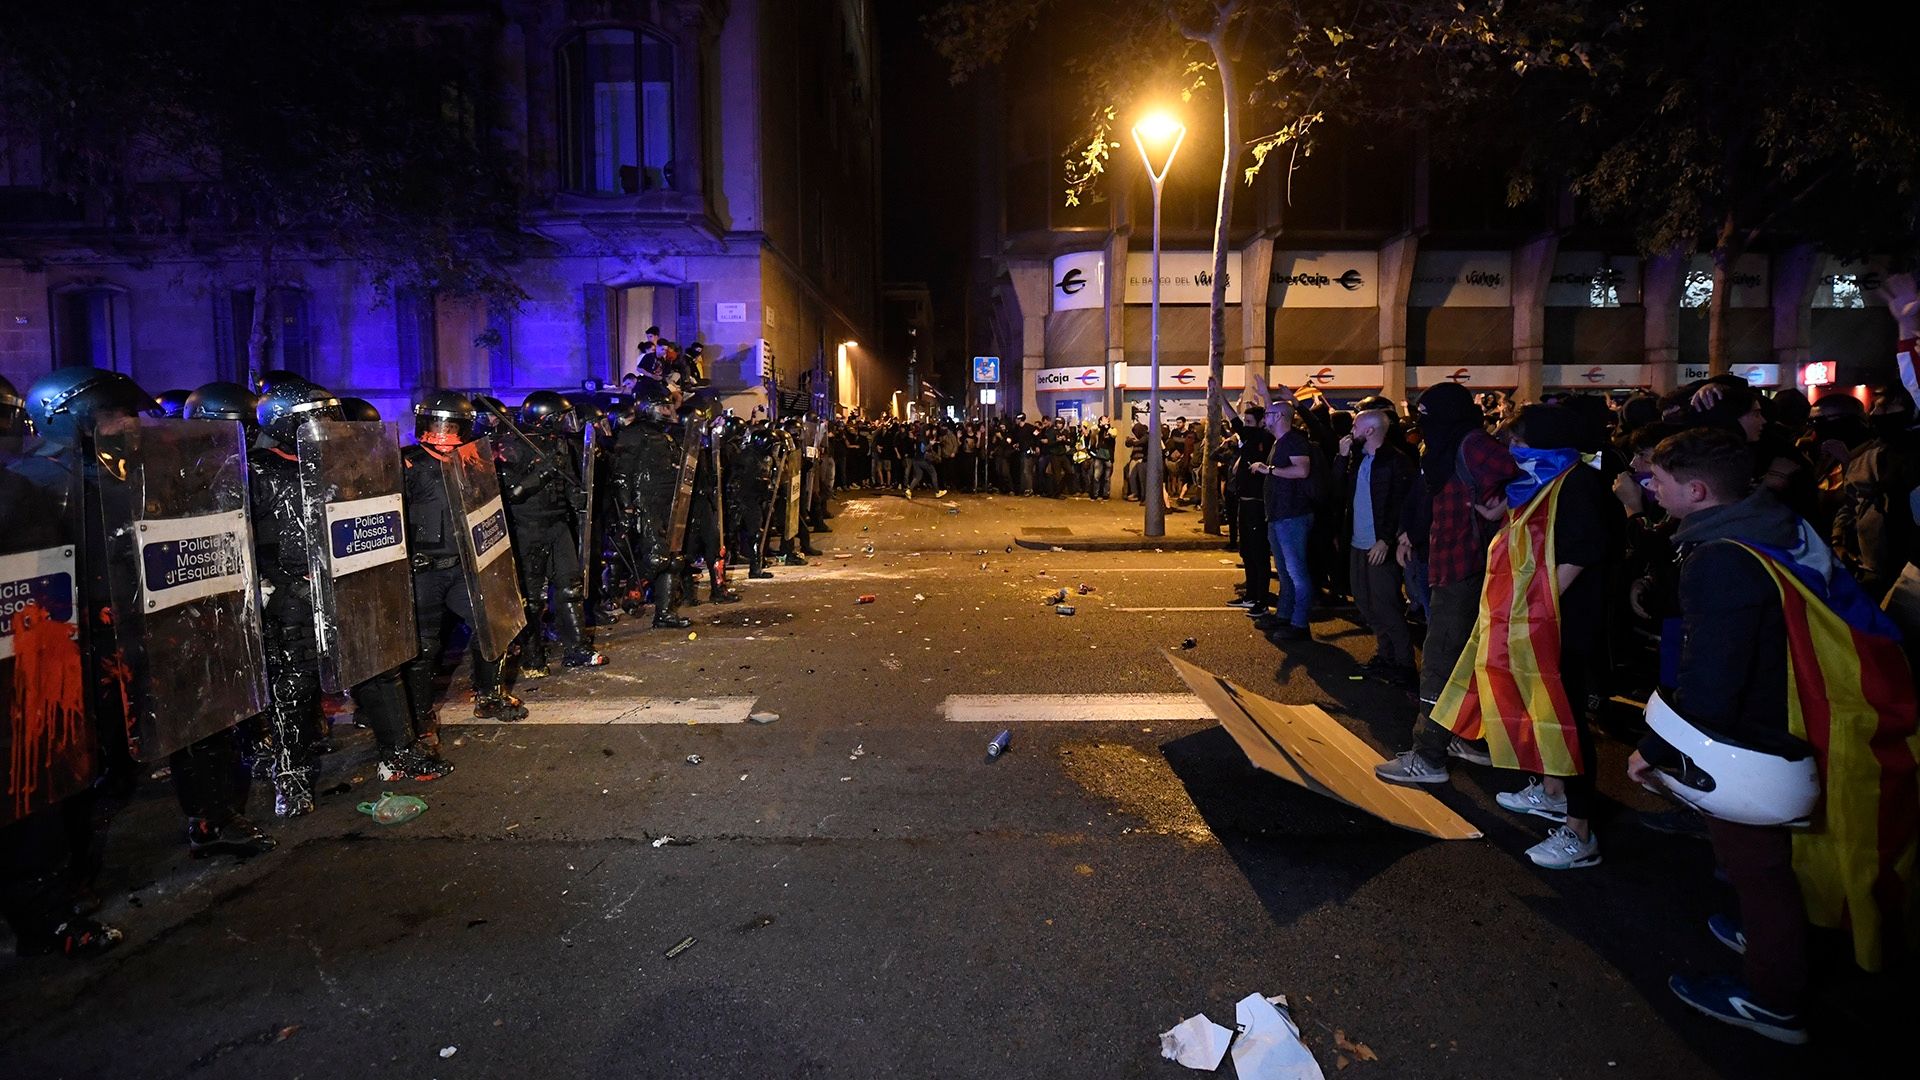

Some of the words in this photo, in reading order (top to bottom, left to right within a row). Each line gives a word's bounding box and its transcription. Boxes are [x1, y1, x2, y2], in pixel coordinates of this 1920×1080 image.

[1130, 277, 1139, 285] EL
[1142, 277, 1170, 285] BACO
[1175, 276, 1190, 285] DEL
[355, 515, 385, 528] Policia
[353, 526, 387, 540] Mossos
[178, 538, 220, 553] Policia
[346, 535, 395, 553] d'Esquadra
[176, 550, 225, 567] Mossos
